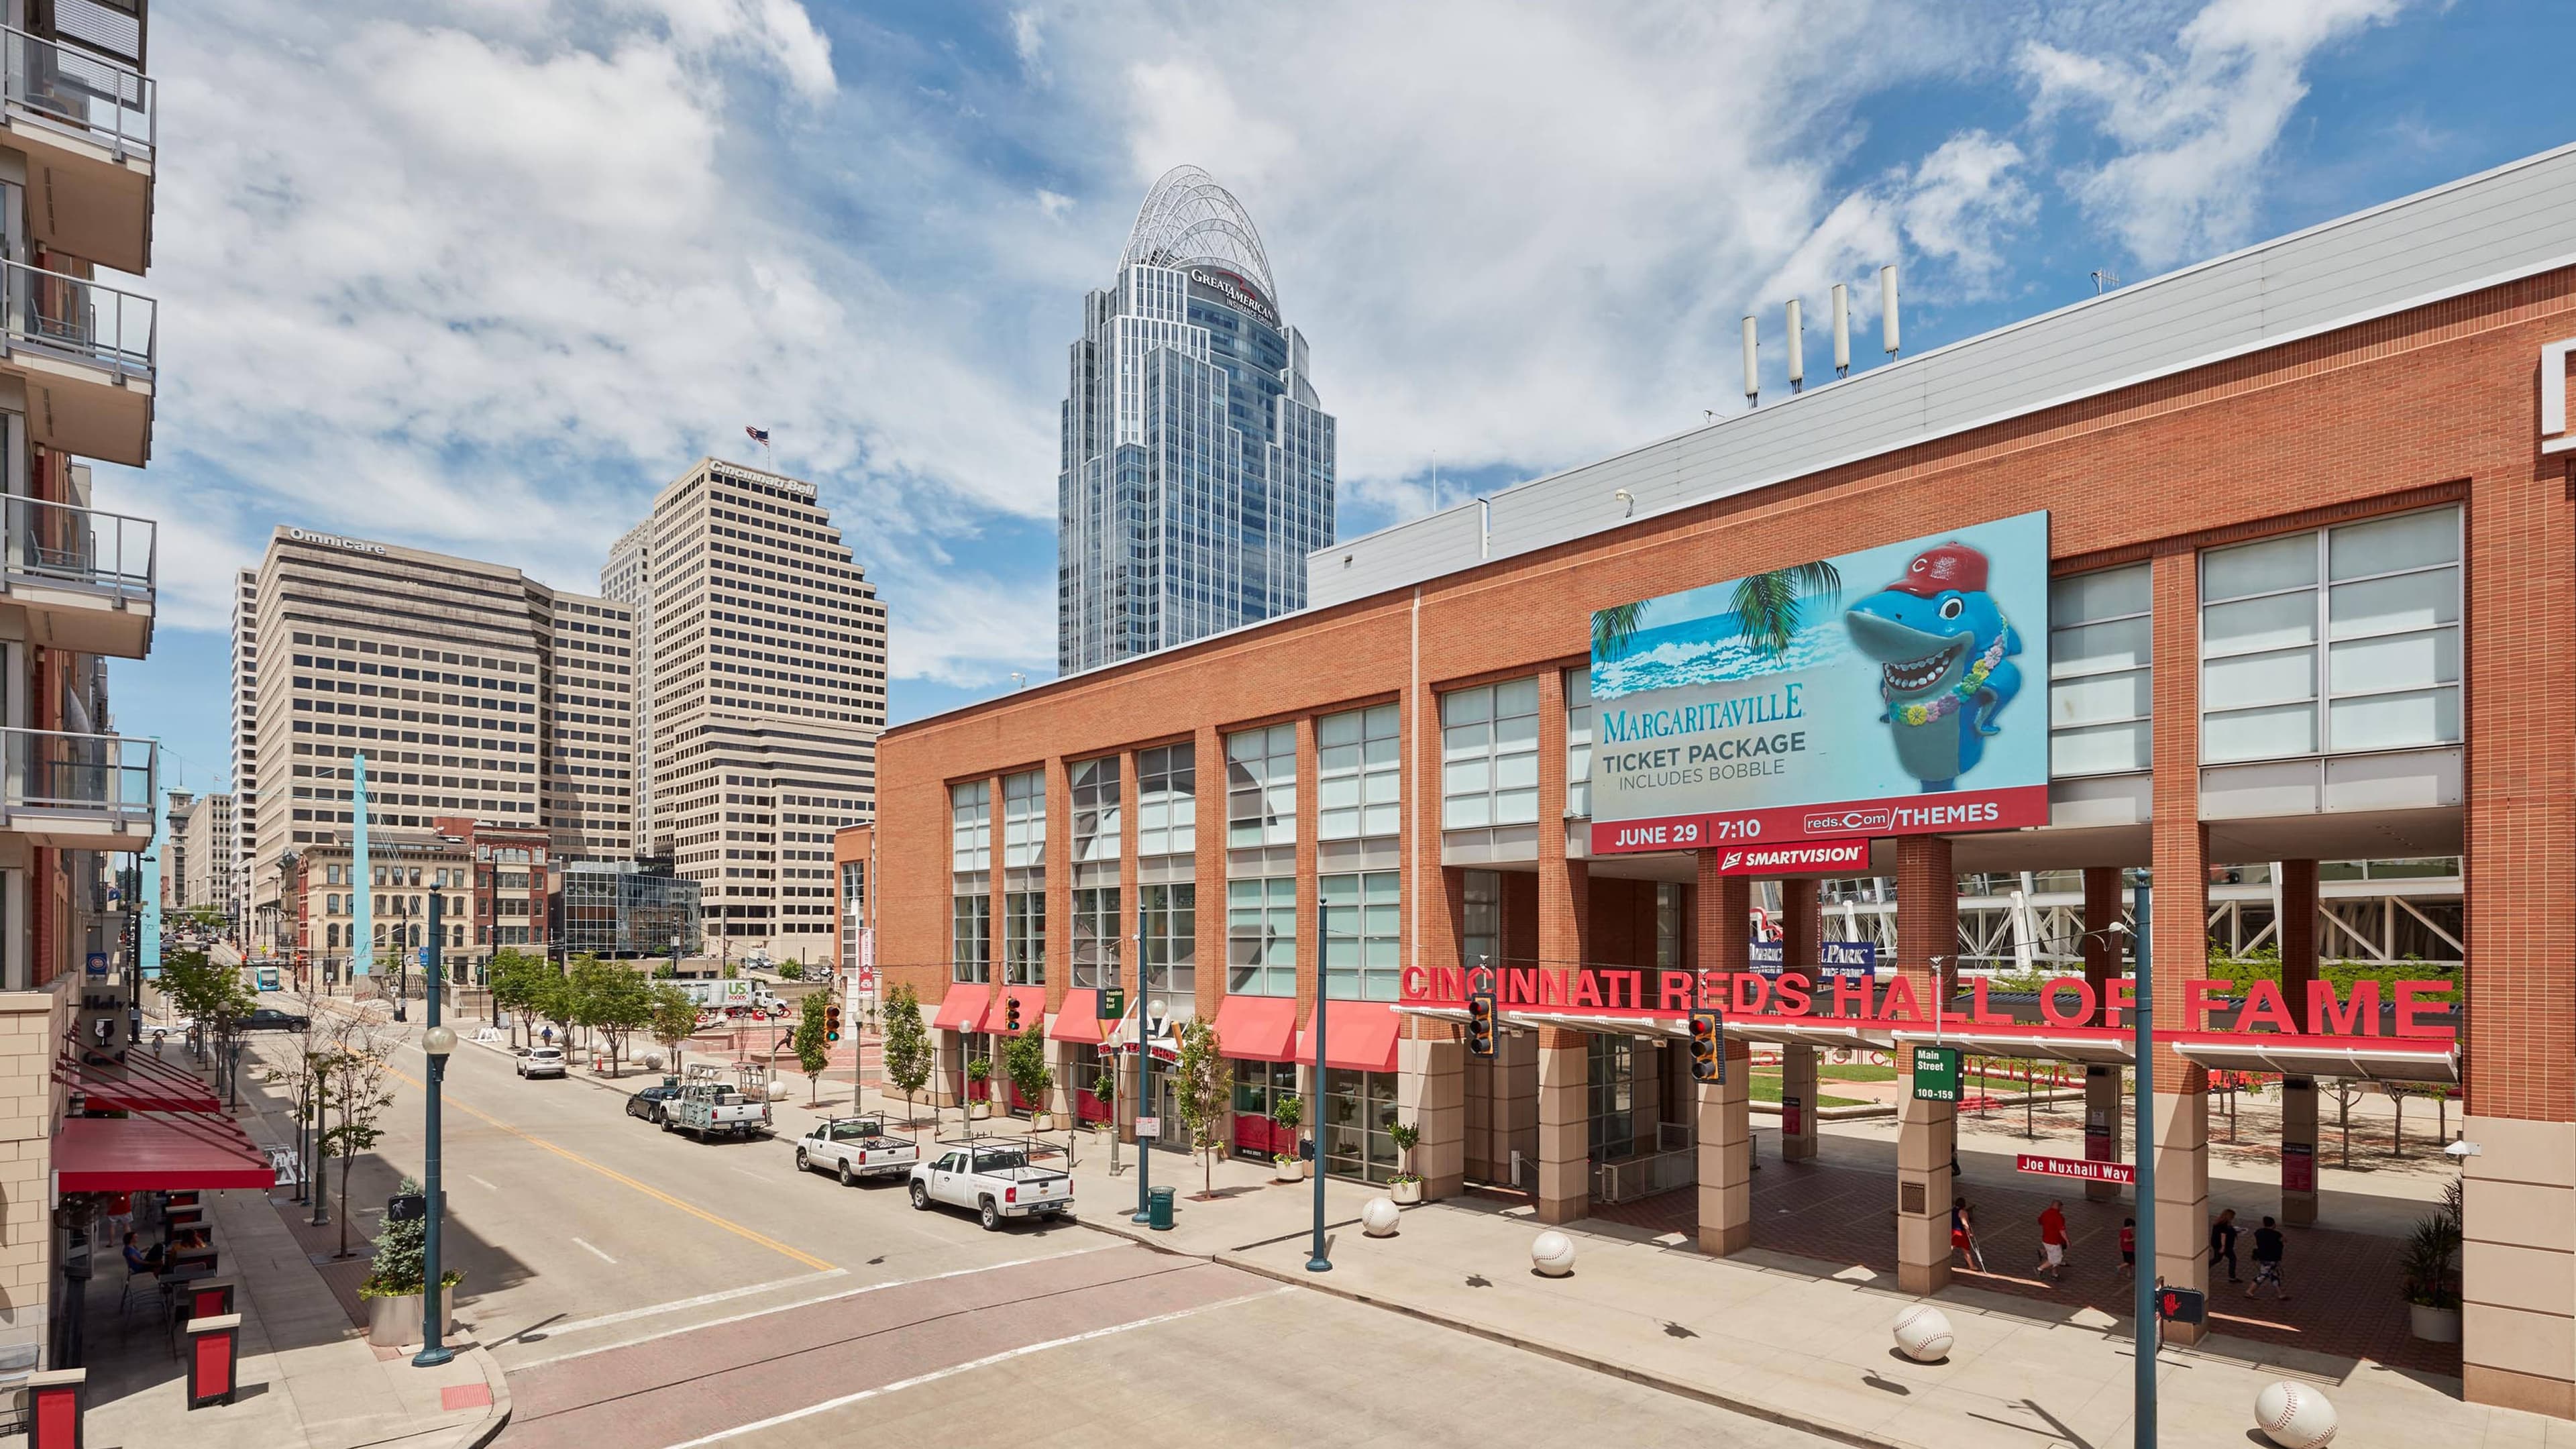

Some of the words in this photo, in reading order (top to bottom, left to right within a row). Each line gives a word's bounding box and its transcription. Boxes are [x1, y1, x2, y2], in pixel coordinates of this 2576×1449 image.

[709, 460, 785, 488] Cincinnati
[788, 480, 816, 496] Bell
[290, 528, 386, 555] Omnicare
[1603, 682, 1803, 745] MARGARITAVILLE
[1603, 747, 1680, 773] TICKET
[1688, 731, 1806, 764] PACKAGE
[1619, 768, 1703, 791] INCLUDES
[1709, 759, 1785, 782] BOBBLE
[1615, 826, 1666, 847] JUNE
[1672, 824, 1698, 843] 29
[1718, 818, 1761, 839] 7:10
[1746, 847, 1860, 867] SMARTVISION
[1827, 945, 1865, 964] PARK
[1403, 965, 1642, 1009] CINCINNATI
[1660, 970, 1811, 1017] REDS
[1833, 975, 2013, 1025] HALL
[2185, 979, 2456, 1037] FAME
[1151, 1046, 1177, 1061] SHOP
[1917, 1061, 1944, 1071] Street
[1918, 1050, 1939, 1060] Main
[1917, 1088, 1953, 1099] 100-159
[2023, 1157, 2044, 1171] Joe
[2049, 1160, 2098, 1177] Nuxhall
[2102, 1165, 2129, 1182] Way
